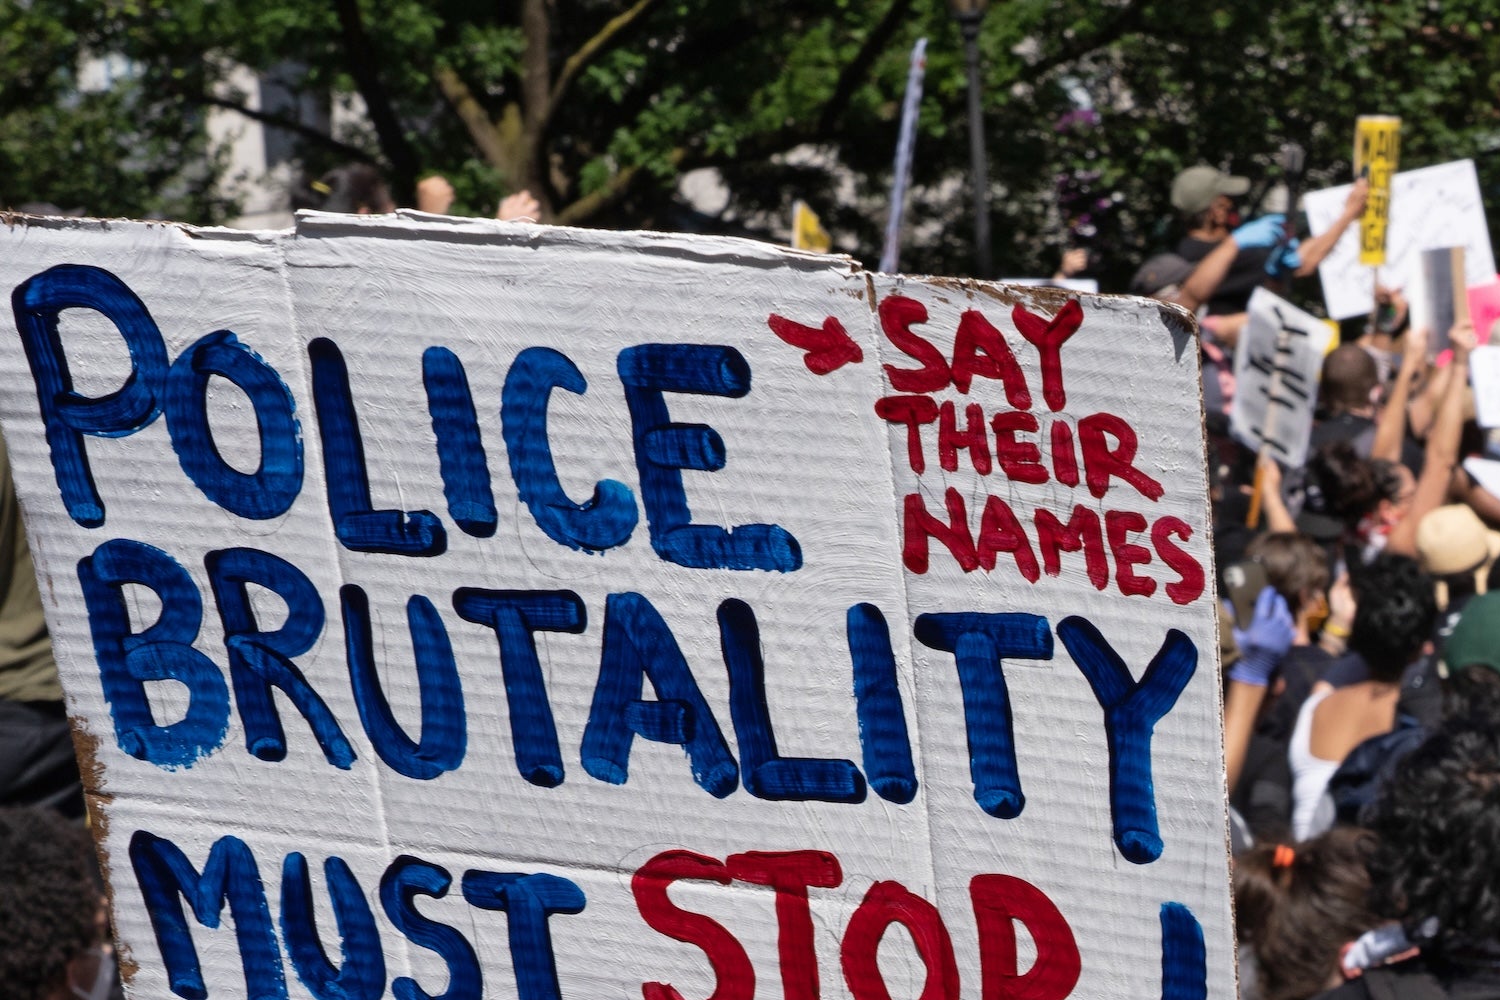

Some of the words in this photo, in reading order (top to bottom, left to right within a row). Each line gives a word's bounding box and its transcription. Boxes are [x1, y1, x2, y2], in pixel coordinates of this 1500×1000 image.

[878, 294, 1084, 411] SAY
[12, 263, 803, 573] POLICE
[874, 394, 1163, 502] THEIR
[902, 487, 1205, 605] NAMES
[77, 538, 1199, 864] BRUTALITY
